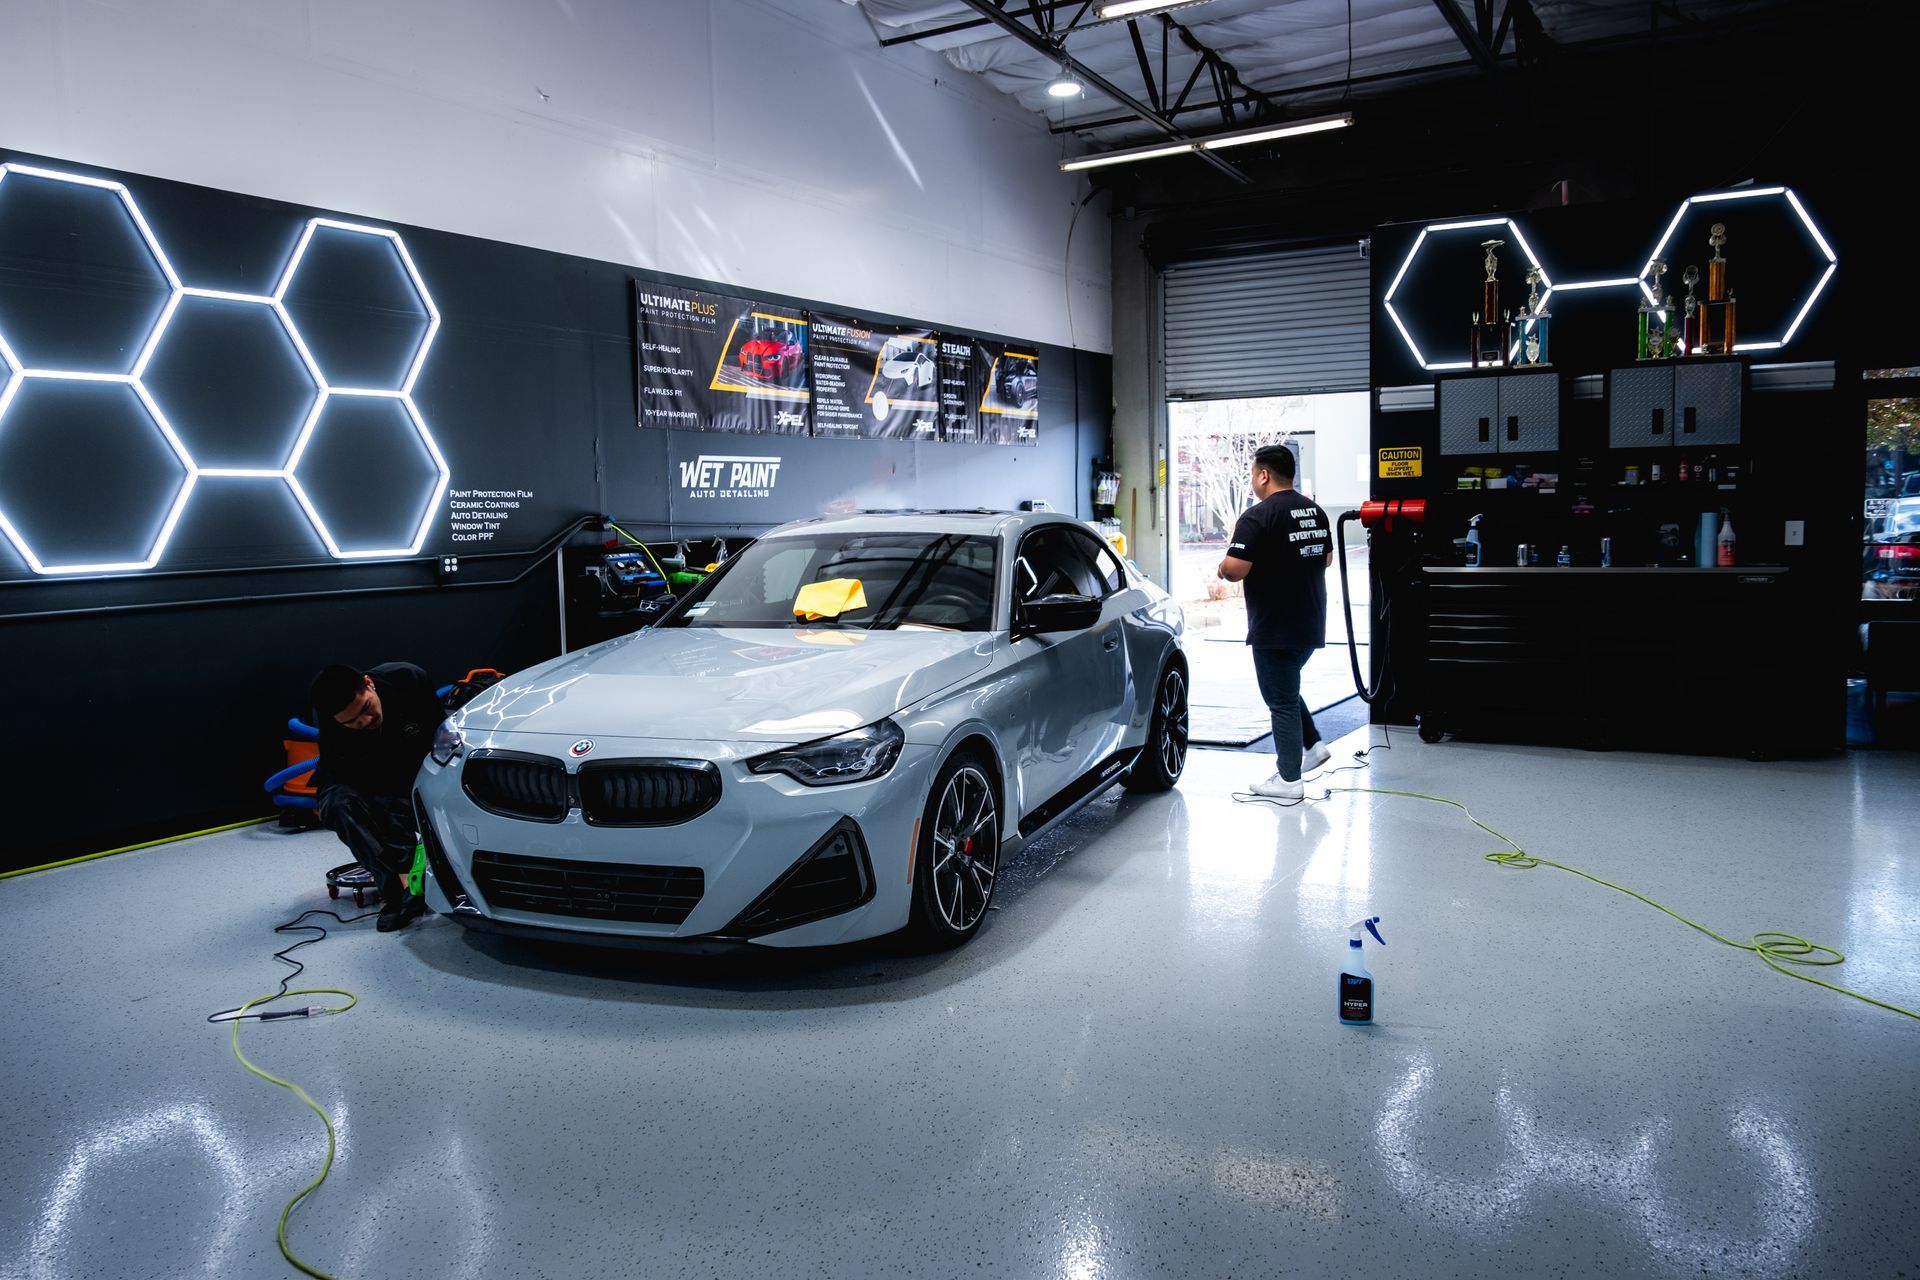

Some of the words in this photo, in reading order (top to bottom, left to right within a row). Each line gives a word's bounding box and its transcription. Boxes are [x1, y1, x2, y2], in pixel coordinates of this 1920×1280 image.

[640, 293, 690, 312] ULTIMATE
[640, 307, 659, 316] PAINT
[661, 310, 700, 322] PROTECTION
[701, 316, 716, 325] FILM
[812, 323, 846, 336] ULTIMATE
[846, 328, 871, 339] FUSION
[829, 335, 858, 345] PROTECTION
[642, 342, 681, 354] SELF-HEALING
[942, 343, 971, 356] STEALTH
[643, 364, 671, 374] SUPERIOR
[671, 368, 694, 376] CLARITY
[826, 362, 850, 370] PROTECTION
[644, 387, 674, 396] FLAWLESS
[645, 409, 667, 417] 10-YEAR
[667, 411, 698, 419] WARRANTY
[775, 411, 805, 426] XPEL
[913, 419, 936, 432] XPEL
[1381, 450, 1419, 460] CAUTION
[680, 456, 725, 488] WET
[730, 462, 780, 488] PAINT
[690, 490, 716, 498] AUTO
[720, 489, 769, 498] DETAILING
[1290, 507, 1318, 519] QUALITY
[1299, 518, 1317, 529] OVER
[478, 532, 494, 541] PPF
